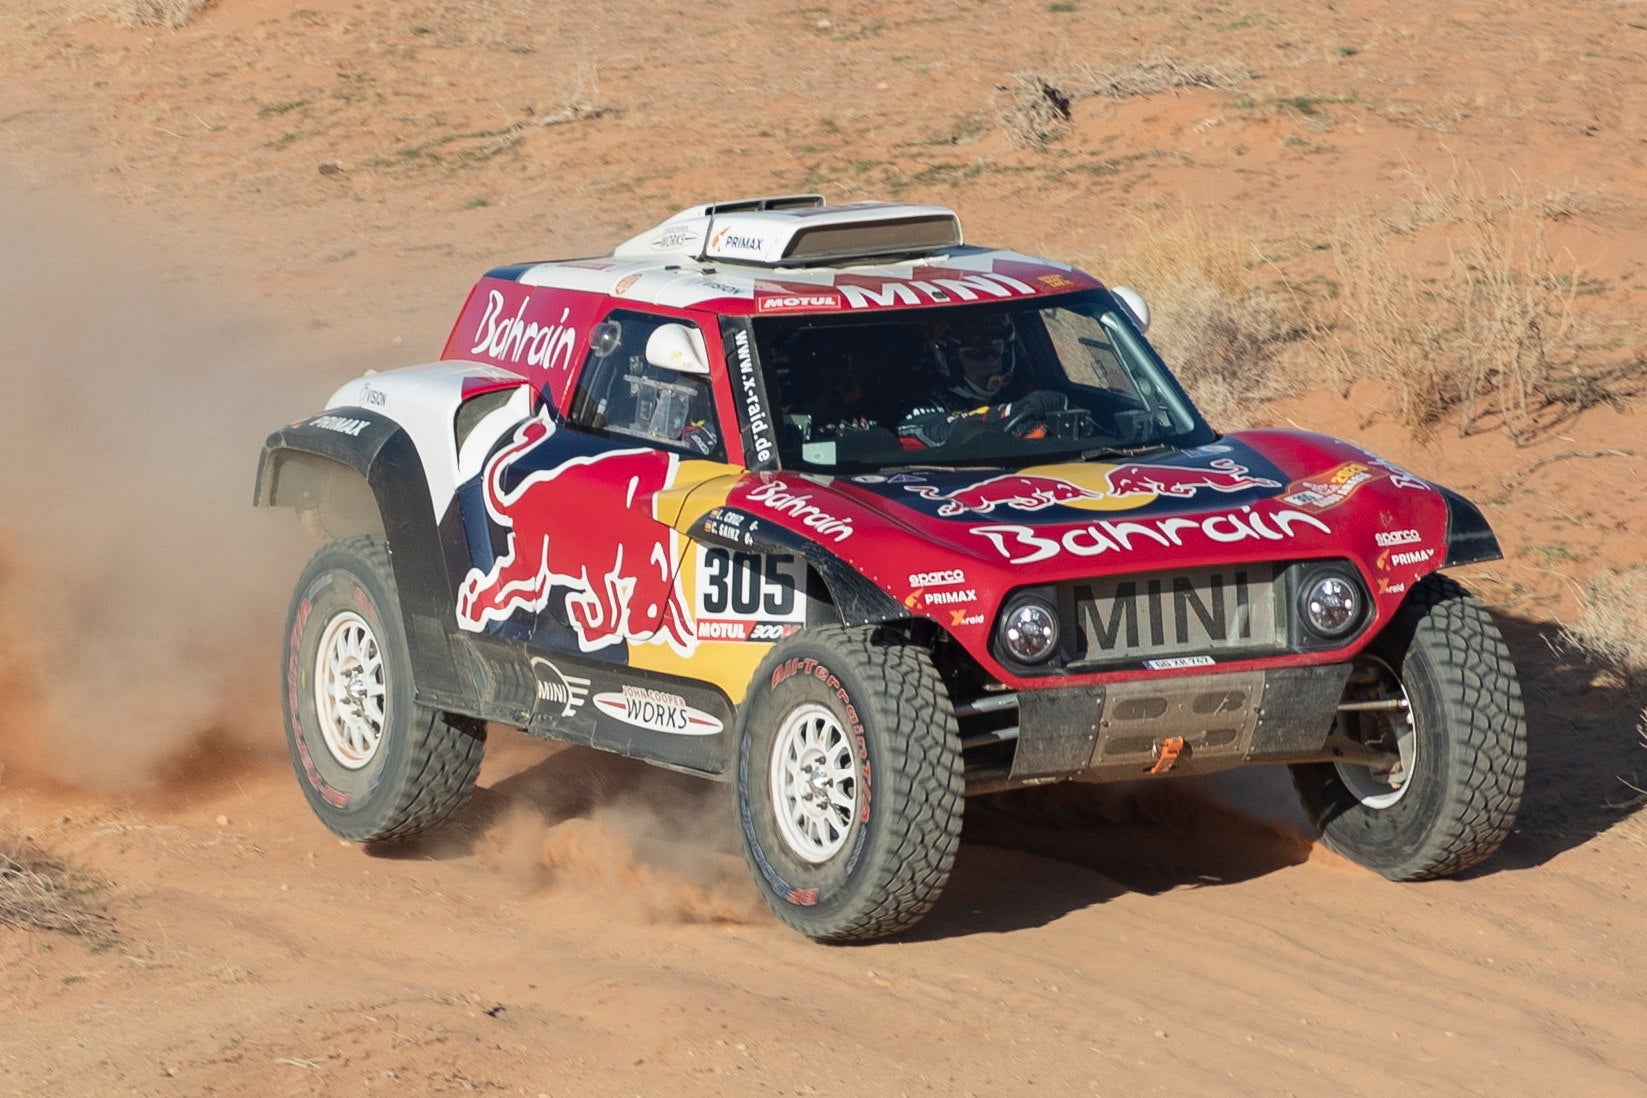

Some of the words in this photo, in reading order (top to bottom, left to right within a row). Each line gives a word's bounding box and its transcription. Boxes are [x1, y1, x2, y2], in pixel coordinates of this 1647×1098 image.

[726, 236, 763, 251] PRIMAX
[764, 296, 836, 308] MOTUL
[836, 273, 1036, 308] MINI
[471, 289, 576, 370] Bahrain
[735, 329, 772, 462] www.x-raid.de
[746, 480, 854, 542] Bahrain
[969, 504, 1331, 565] Bahrain
[1375, 529, 1422, 547] sparco
[703, 547, 796, 616] 305
[908, 569, 965, 587] sparco
[924, 589, 977, 605] PRIMAX
[1074, 571, 1251, 650] MINI
[698, 622, 746, 639] MOTUL
[538, 680, 567, 704] MINI
[622, 685, 647, 699] JOHN
[648, 689, 687, 708] COOPER
[626, 698, 687, 729] WORKS
[771, 657, 868, 759] All-Terrain
